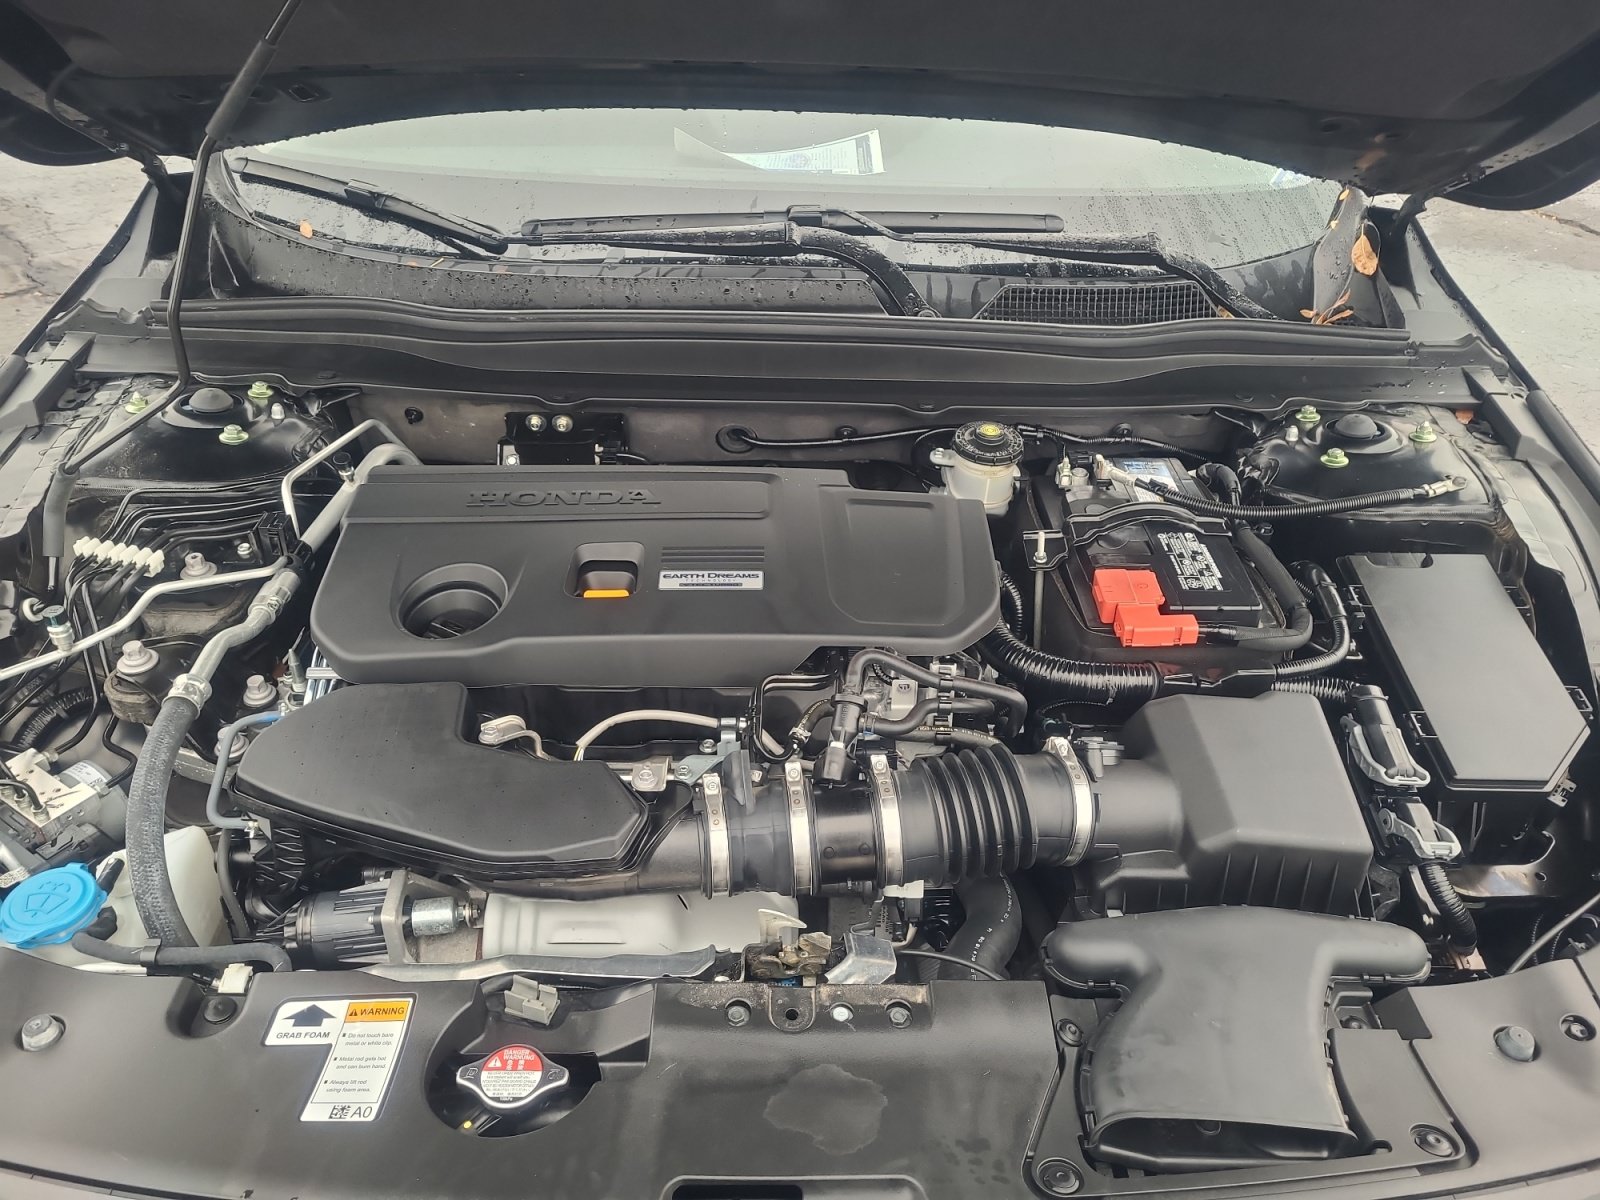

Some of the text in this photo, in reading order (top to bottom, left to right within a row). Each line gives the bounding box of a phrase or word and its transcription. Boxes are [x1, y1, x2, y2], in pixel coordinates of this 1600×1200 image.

[466, 490, 661, 506] HONDA
[360, 1007, 405, 1016] WARNING
[304, 1031, 331, 1039] FOAM
[350, 1106, 373, 1119] A0
